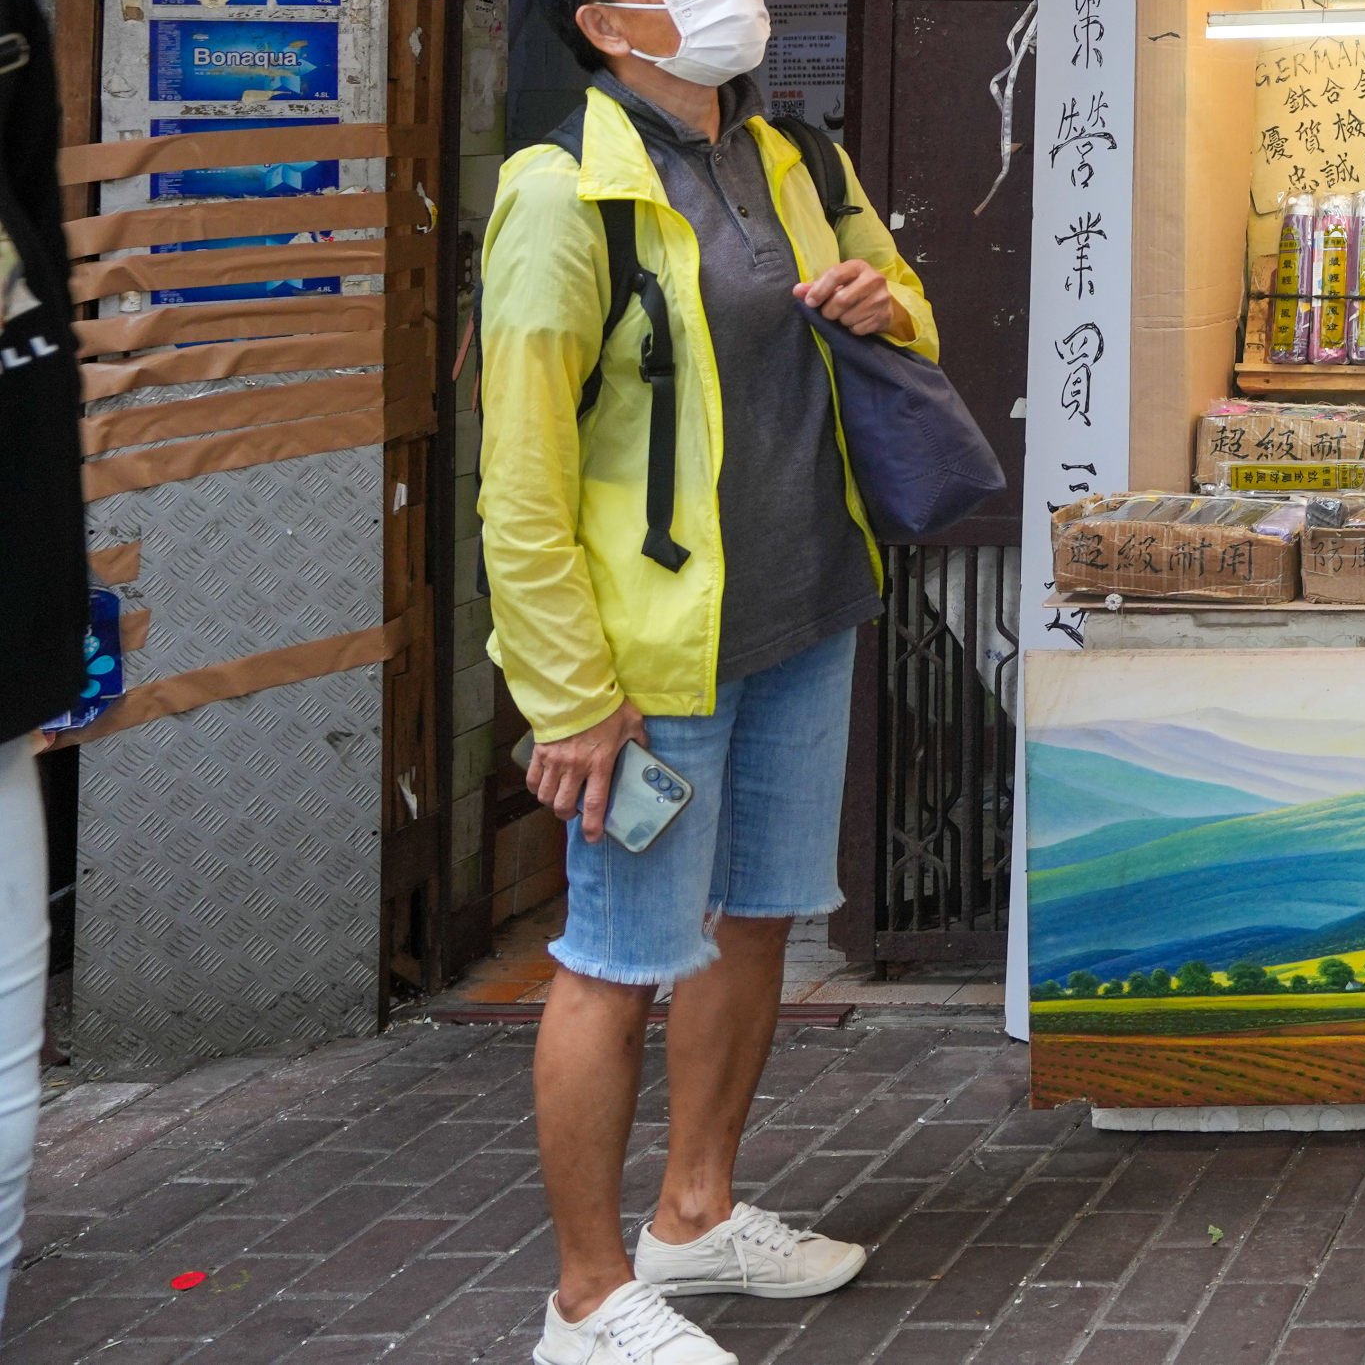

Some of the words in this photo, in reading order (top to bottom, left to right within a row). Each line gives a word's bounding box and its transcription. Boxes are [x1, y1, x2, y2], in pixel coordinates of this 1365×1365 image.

[193, 47, 298, 69] Bonaqua
[1278, 259, 1293, 333] 最輕風傘
[1068, 531, 1254, 583] 超級耐用
